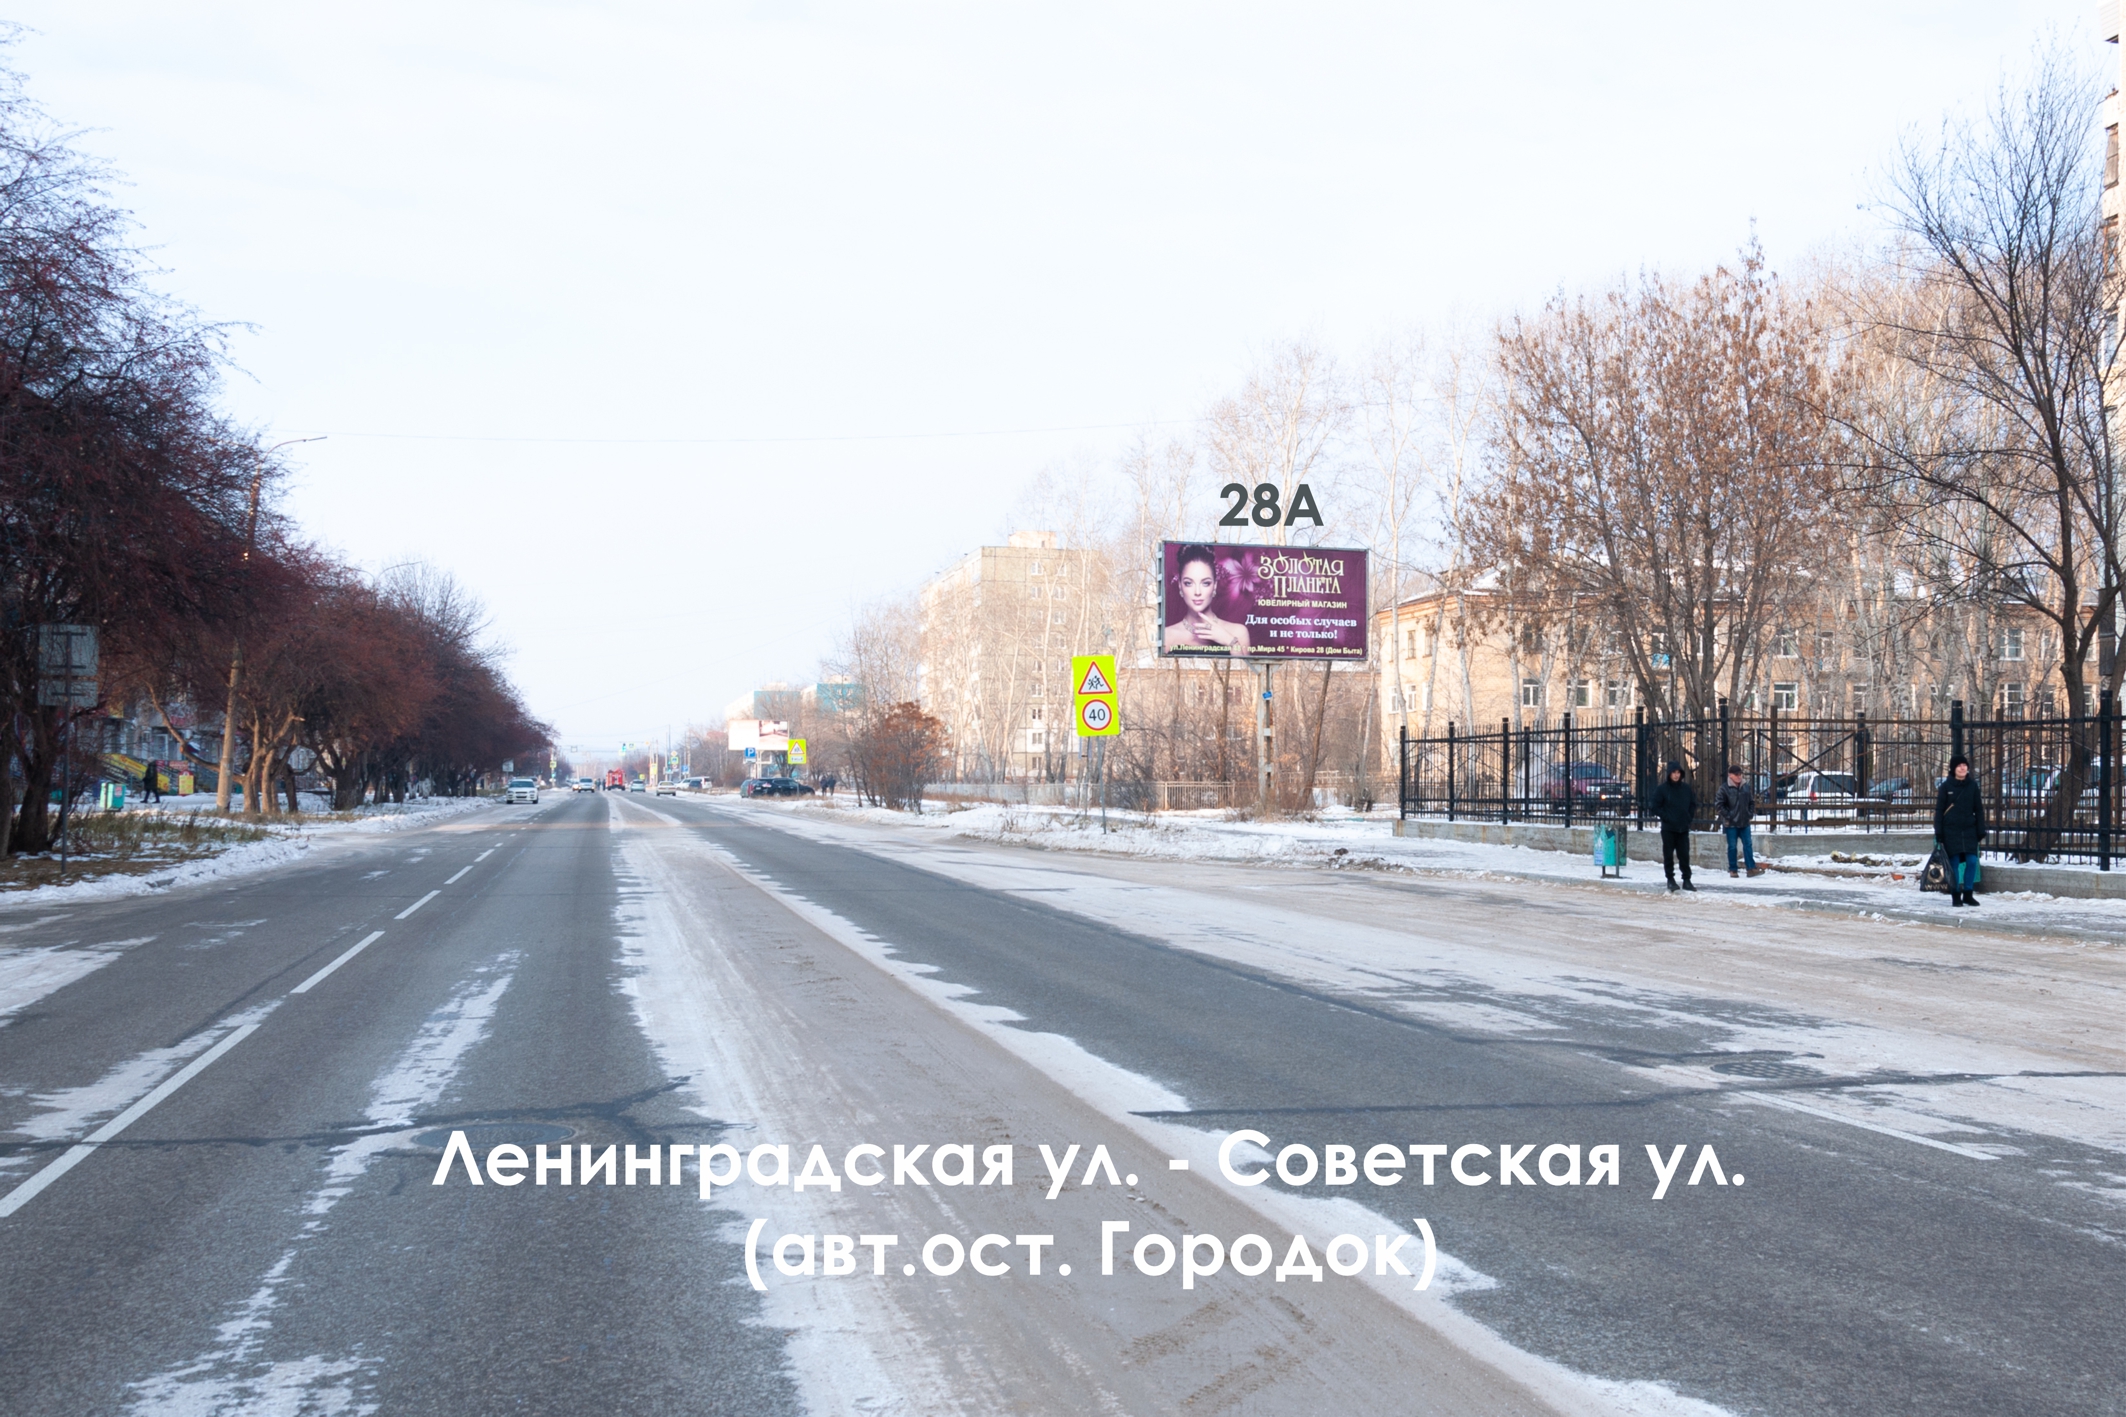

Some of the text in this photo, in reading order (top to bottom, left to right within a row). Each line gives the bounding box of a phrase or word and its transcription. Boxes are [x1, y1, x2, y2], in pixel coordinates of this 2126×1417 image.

[1257, 599, 1347, 609] ЮВЕЛИРНЫЙ МАГАЗИН
[1245, 614, 1357, 628] Для особых случаев
[1269, 629, 1338, 640] и не только!
[1290, 646, 1315, 654] Кирова
[1325, 646, 1341, 654] (Дом
[1342, 646, 1363, 655] Быта)
[1088, 708, 1106, 721] 40
